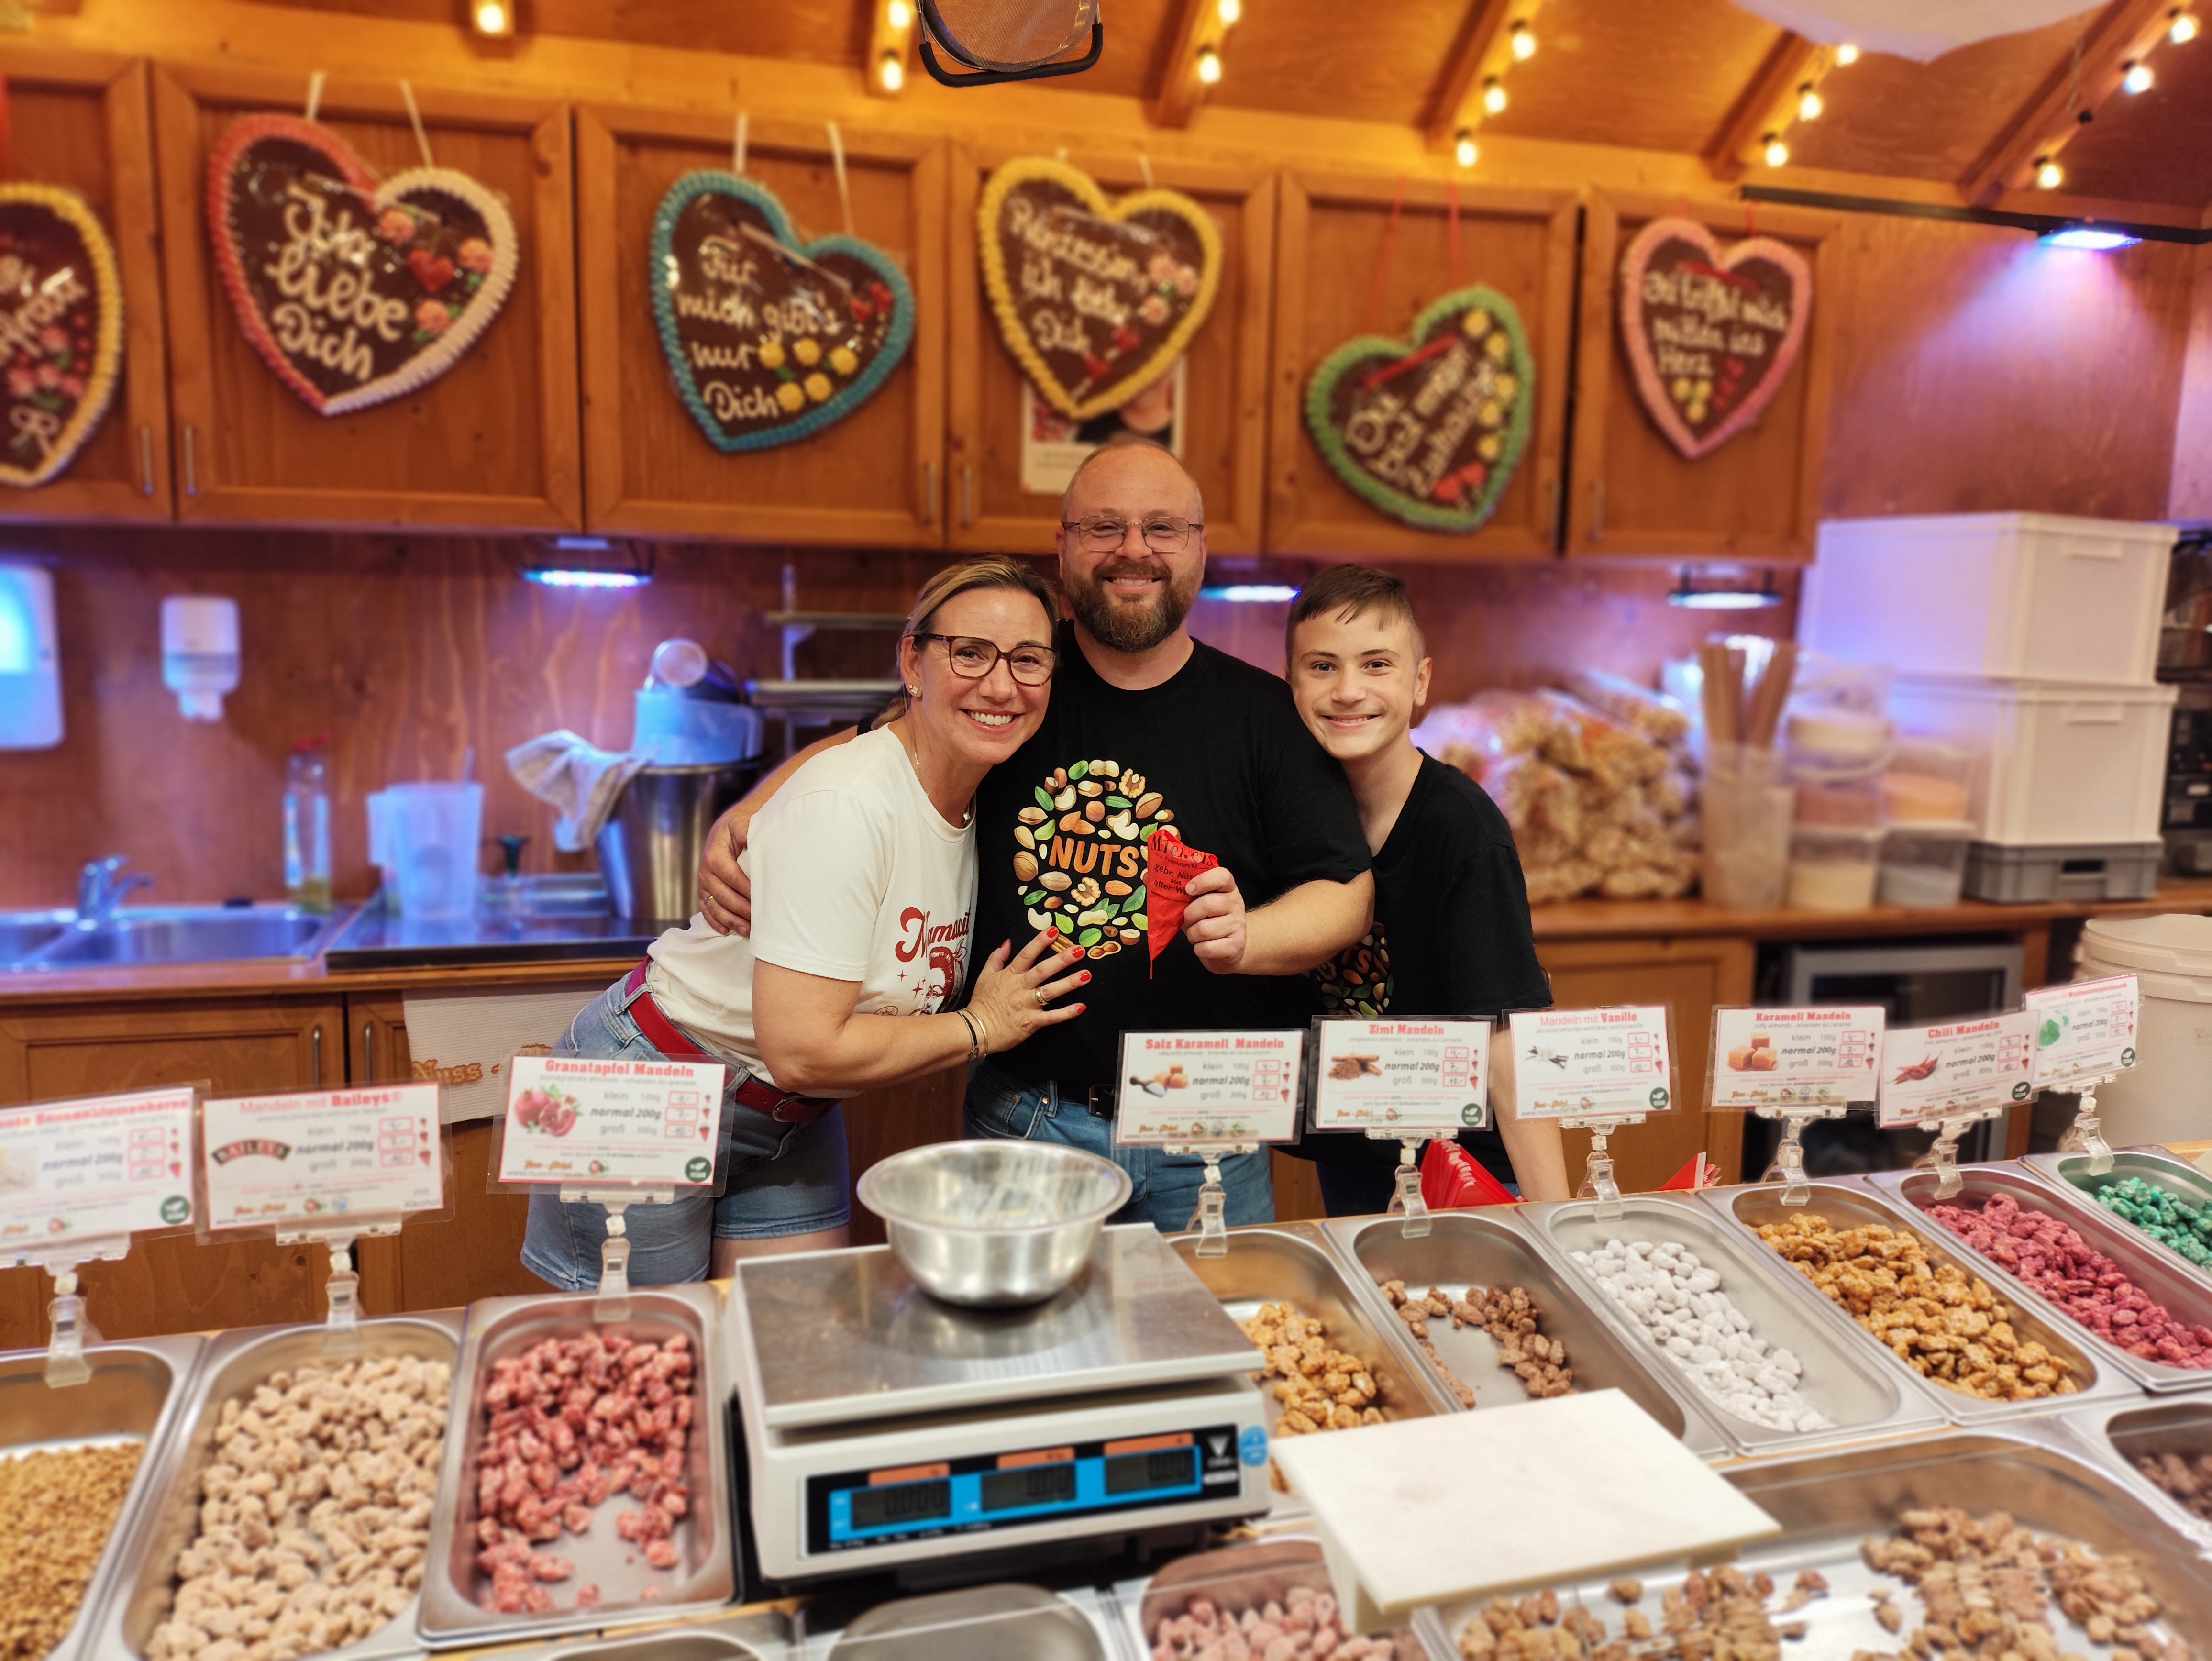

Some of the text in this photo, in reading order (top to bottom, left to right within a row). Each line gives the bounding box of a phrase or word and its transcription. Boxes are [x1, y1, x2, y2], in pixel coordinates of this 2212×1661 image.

[265, 246, 408, 342] liebe
[273, 302, 373, 381] Dich
[704, 380, 779, 421] Dich
[1049, 835, 1139, 877] NUTS
[1154, 864, 1195, 880] gebr. Nüs
[1154, 880, 1172, 891] aller
[1540, 1012, 1637, 1027] Mandeln mit Vanille
[1755, 1011, 1851, 1021] Karamell Mandeln
[1369, 1024, 1445, 1035] Zimt Mandeln
[1927, 1020, 2000, 1039] Chili Mandeln
[2072, 1018, 2108, 1031] normal 200g
[1581, 1037, 1599, 1045] klein
[1791, 1033, 1811, 1041] klein
[1820, 1034, 1836, 1042] 100g
[1145, 1037, 1284, 1050] Salz Karamell Mandeln
[1954, 1041, 1995, 1054] klein 100g
[1394, 1047, 1414, 1056] klein
[1423, 1048, 1439, 1057] 100g
[1574, 1050, 1605, 1060] normal
[1607, 1050, 1626, 1060] 200g
[1781, 1046, 1816, 1055] normal
[1816, 1046, 1837, 1056] 200g
[1202, 1062, 1250, 1071] klein 100g
[1384, 1061, 1419, 1071] normal
[1419, 1062, 1440, 1072] 200g
[1789, 1059, 1833, 1069] groß 300g
[1945, 1053, 1996, 1069] normal 200g
[545, 1059, 694, 1077] Granatapfel Mandeln
[1583, 1064, 1602, 1075] groß
[1192, 1075, 1250, 1086] normal 200g
[1393, 1076, 1413, 1086] groß
[1421, 1077, 1437, 1085] 300g
[1952, 1070, 1971, 1081] groß
[603, 1091, 629, 1101] klein
[1200, 1090, 1221, 1101] groß
[240, 1099, 302, 1113] Mandeln
[590, 1107, 662, 1120] normal 200g
[599, 1124, 626, 1135] groß
[295, 1141, 344, 1155] normal
